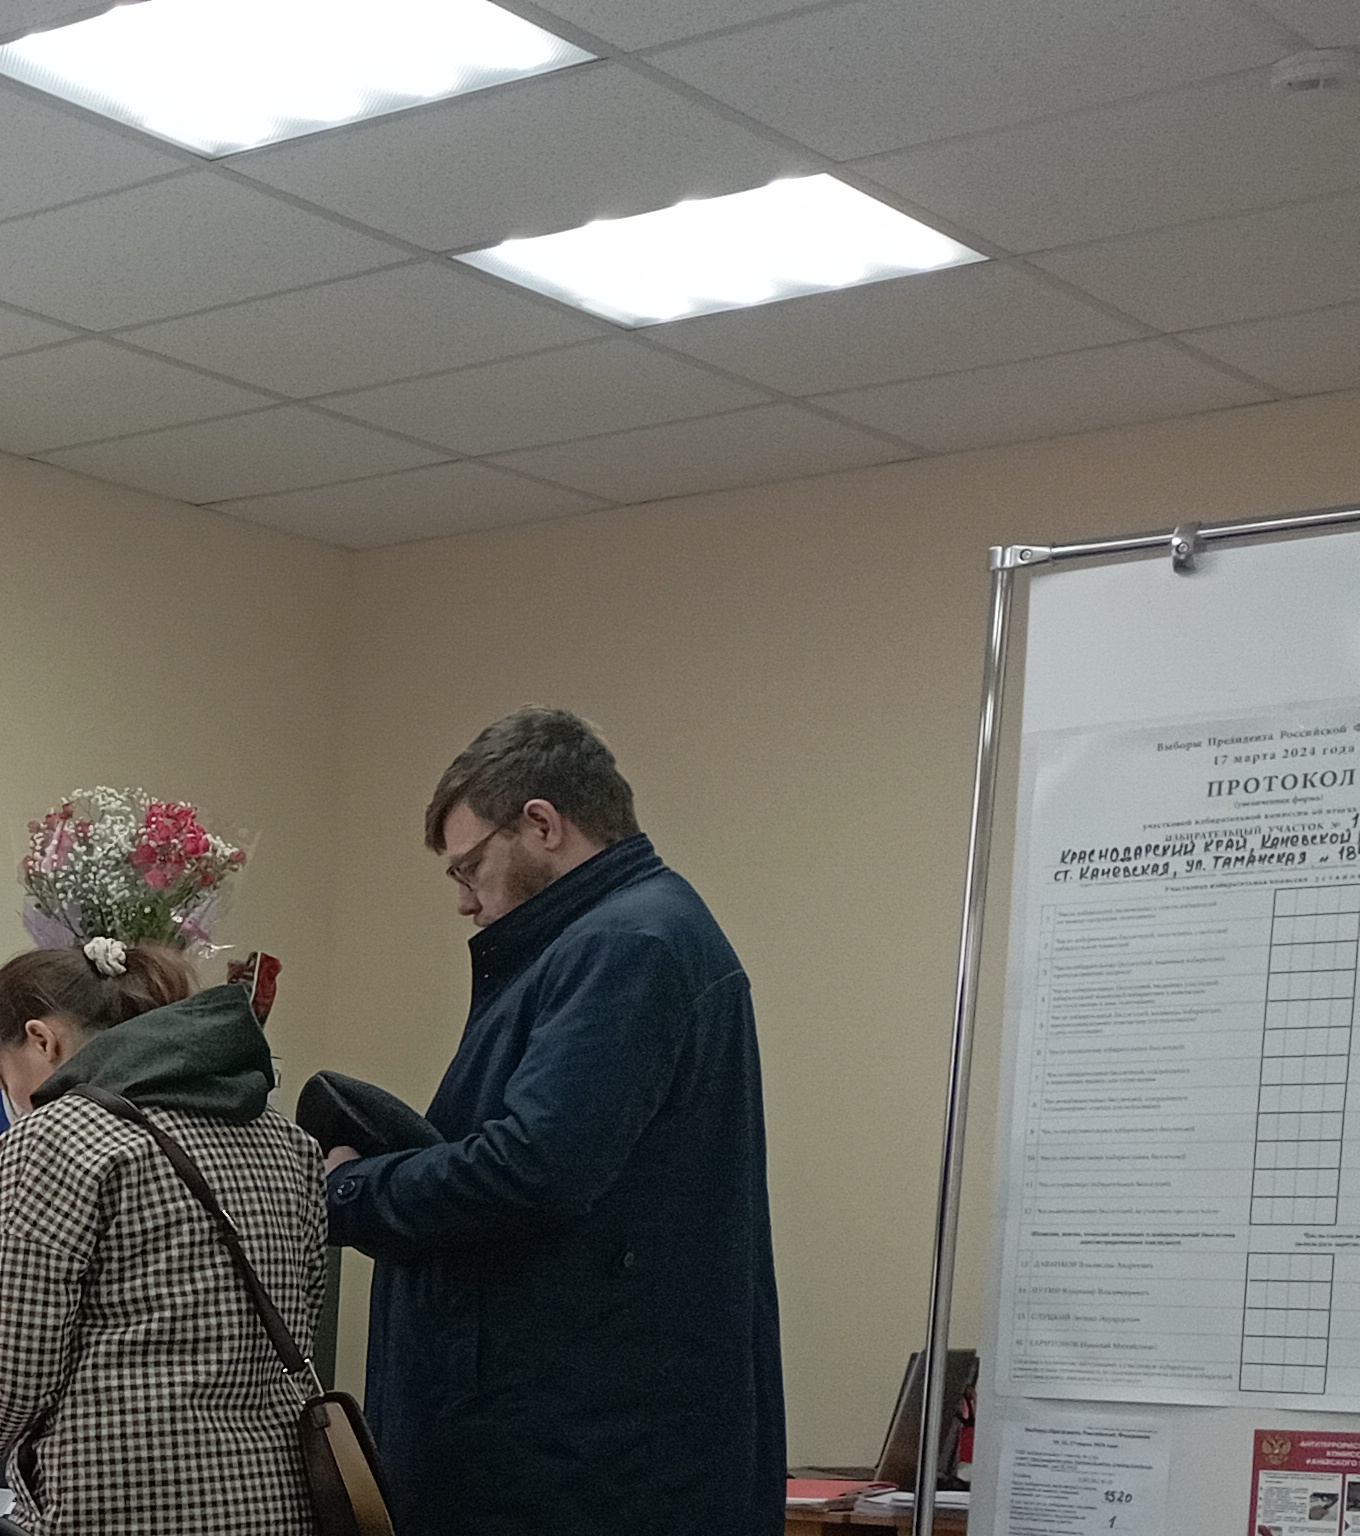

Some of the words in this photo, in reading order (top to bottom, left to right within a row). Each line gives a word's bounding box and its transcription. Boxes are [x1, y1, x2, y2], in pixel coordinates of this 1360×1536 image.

[1208, 733, 1274, 748] Президента
[1280, 725, 1347, 739] Российской
[1213, 754, 1229, 766] 17
[1233, 752, 1276, 765] марта
[1282, 746, 1316, 759] 2024
[1322, 744, 1355, 756] года
[1206, 769, 1356, 798] ПРОТОКОЛ
[1104, 1489, 1133, 1503] 1520
[1108, 1515, 1117, 1529] 1
